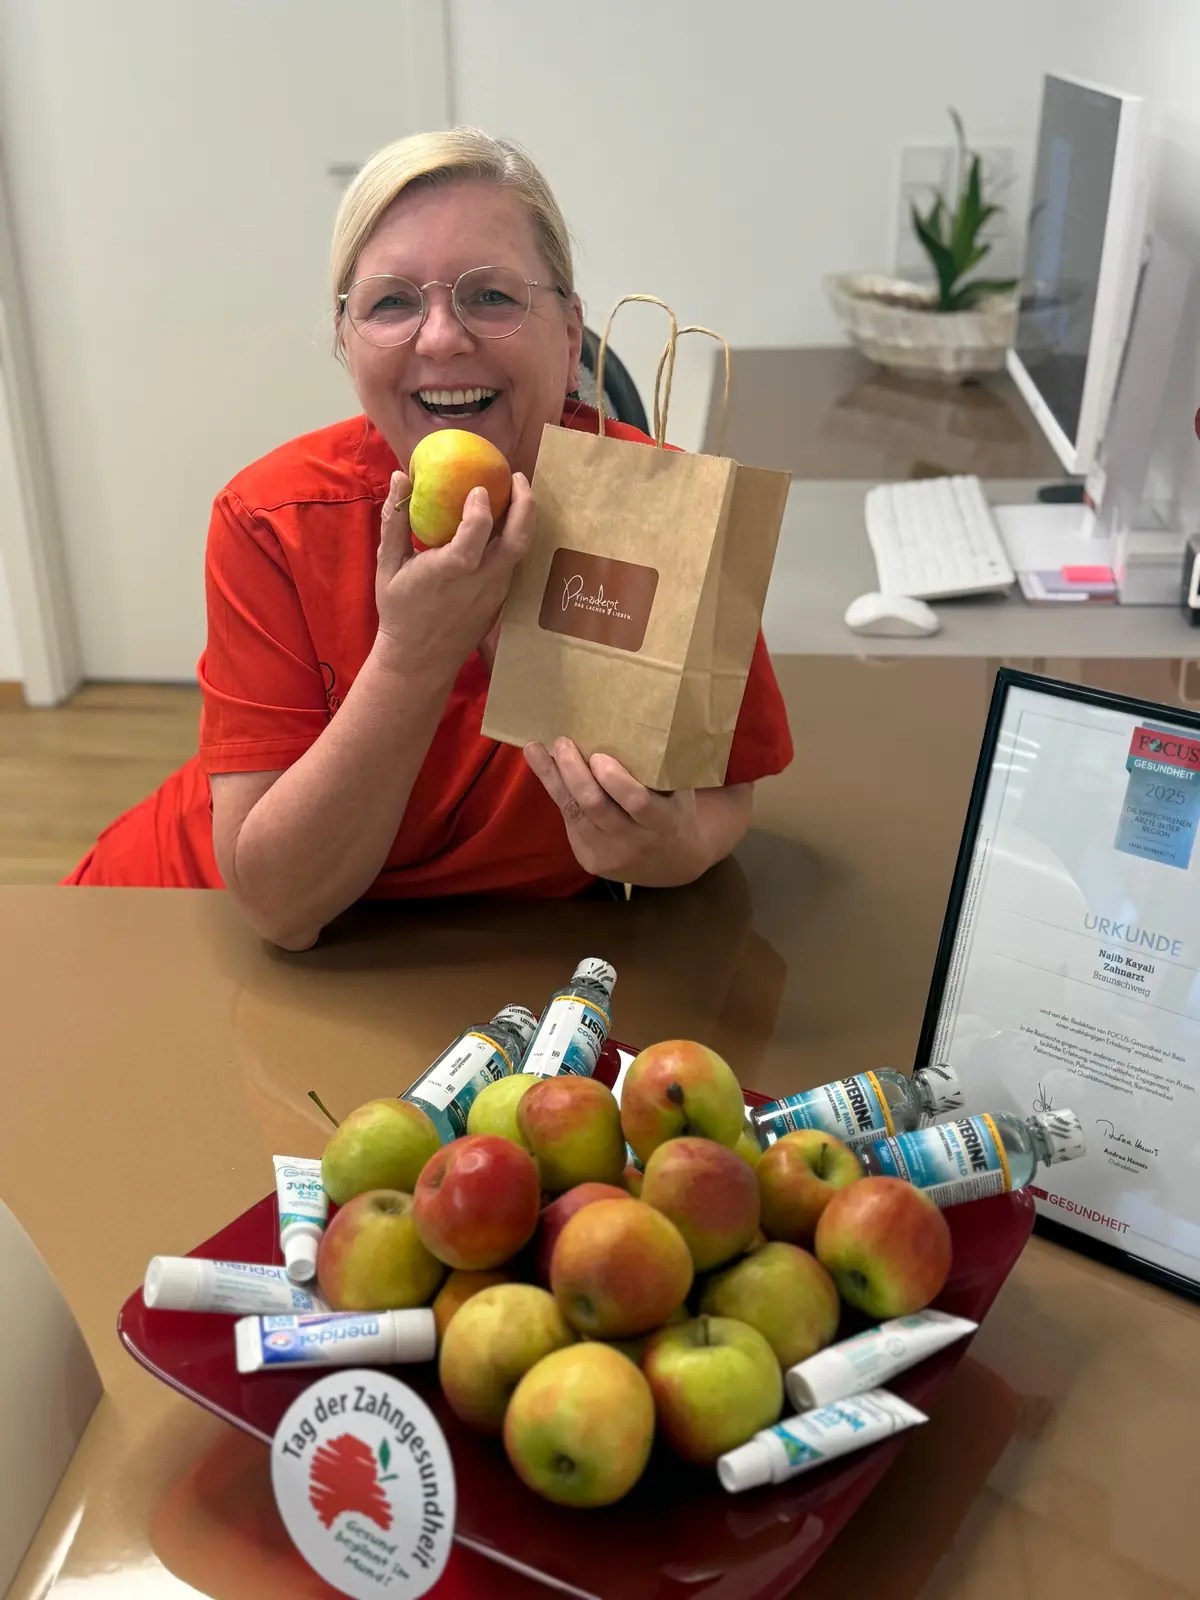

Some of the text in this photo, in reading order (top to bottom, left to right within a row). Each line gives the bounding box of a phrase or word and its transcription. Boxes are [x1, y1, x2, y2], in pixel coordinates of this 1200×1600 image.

[1138, 734, 1200, 763] FOCUS
[1133, 758, 1195, 781] GESUNDHEIT
[1145, 783, 1186, 806] 2025
[1141, 825, 1171, 839] REGION
[1084, 912, 1183, 957] URKUNDE
[1098, 949, 1155, 974] Najib Kayali
[1103, 962, 1145, 982] Zahnarzt
[1092, 970, 1151, 998] Braunschweig
[580, 1014, 607, 1045] LISTE
[1056, 1022, 1069, 1030] einer
[833, 1089, 849, 1111] MINT
[841, 1112, 856, 1136] MILD
[841, 1077, 876, 1133] STERINE
[945, 1127, 960, 1150] MINT
[953, 1150, 968, 1177] MILD
[955, 1117, 989, 1174] STERINE
[1103, 1147, 1126, 1162] Andrea
[286, 1181, 325, 1192] JUNIO
[1049, 1193, 1130, 1234] GESUNDHEIT
[298, 1322, 380, 1348] meridol
[282, 1385, 446, 1570] Tag der Zahngesundheit
[334, 1530, 390, 1567] beginnt
[345, 1519, 398, 1556] Gesund
[343, 1554, 395, 1588] Mund!
